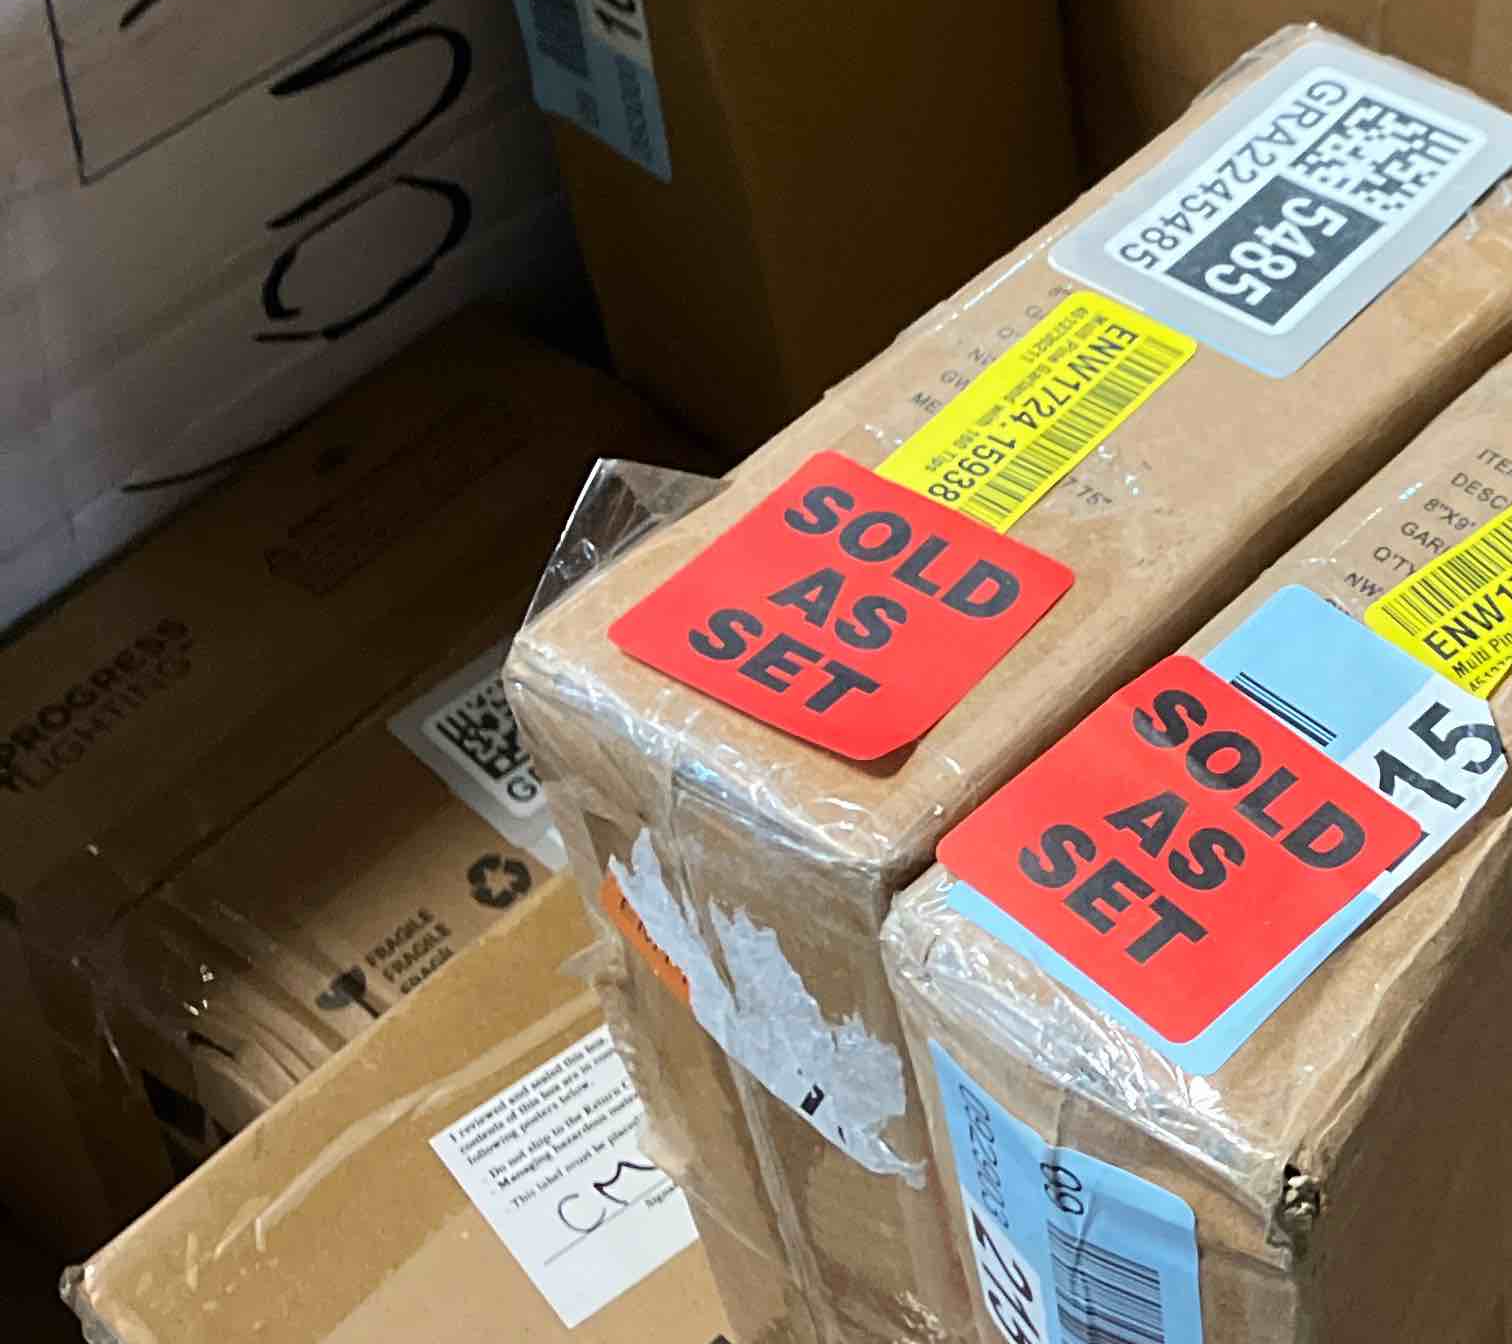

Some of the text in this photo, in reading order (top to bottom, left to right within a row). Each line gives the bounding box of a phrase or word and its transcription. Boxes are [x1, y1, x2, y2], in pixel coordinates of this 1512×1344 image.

[1119, 78, 1346, 273] GRA2245485
[1204, 195, 1348, 307] 5485
[783, 485, 1021, 620] SOLD
[1400, 520, 1451, 555] GAR
[688, 607, 881, 715] SET
[768, 566, 909, 651] AS
[1451, 644, 1490, 679] Multi
[1132, 688, 1367, 870] SOLD
[1018, 822, 1209, 967] SET
[1105, 789, 1248, 892] AS
